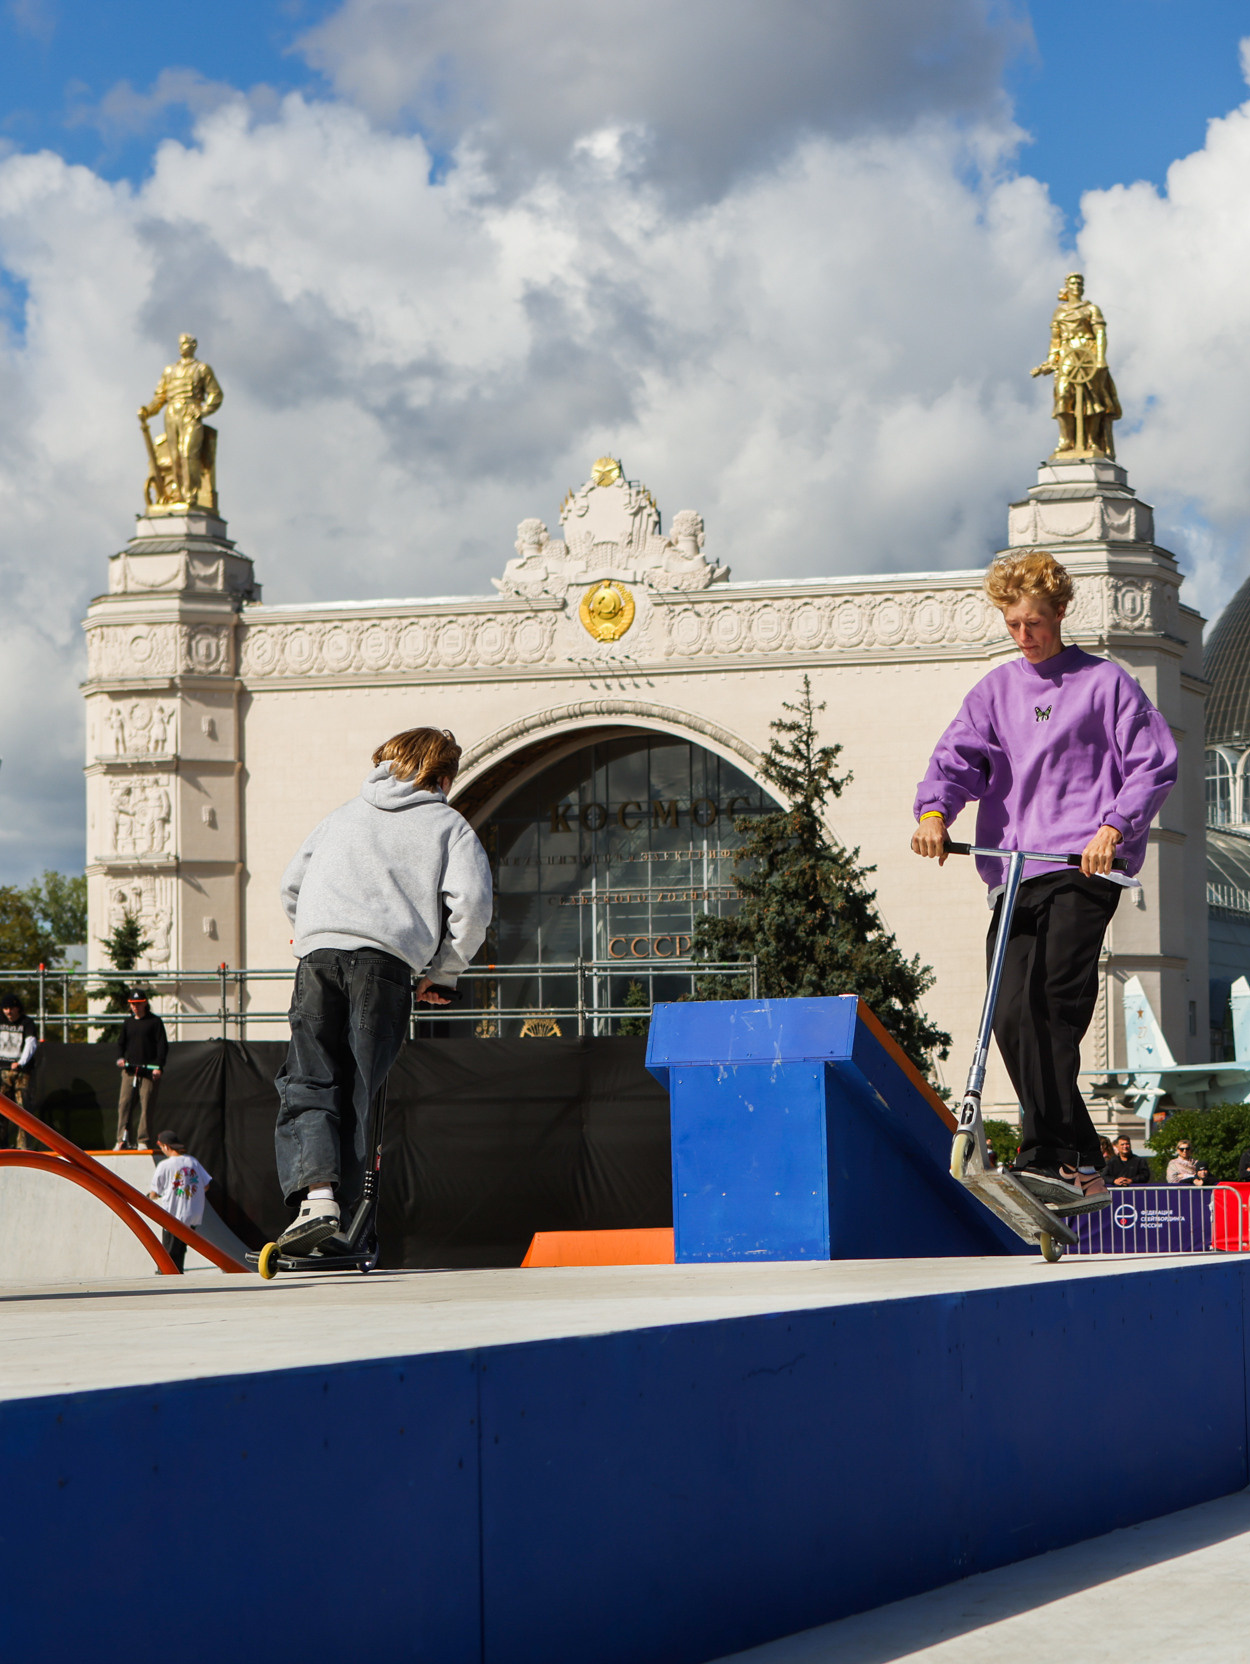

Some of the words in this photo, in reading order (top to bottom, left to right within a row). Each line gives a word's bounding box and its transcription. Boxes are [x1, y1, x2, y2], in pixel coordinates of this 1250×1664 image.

[550, 796, 750, 833] КОСМОС
[641, 849, 731, 862] ЭЛЕКТРИФ
[609, 936, 691, 958] СССР
